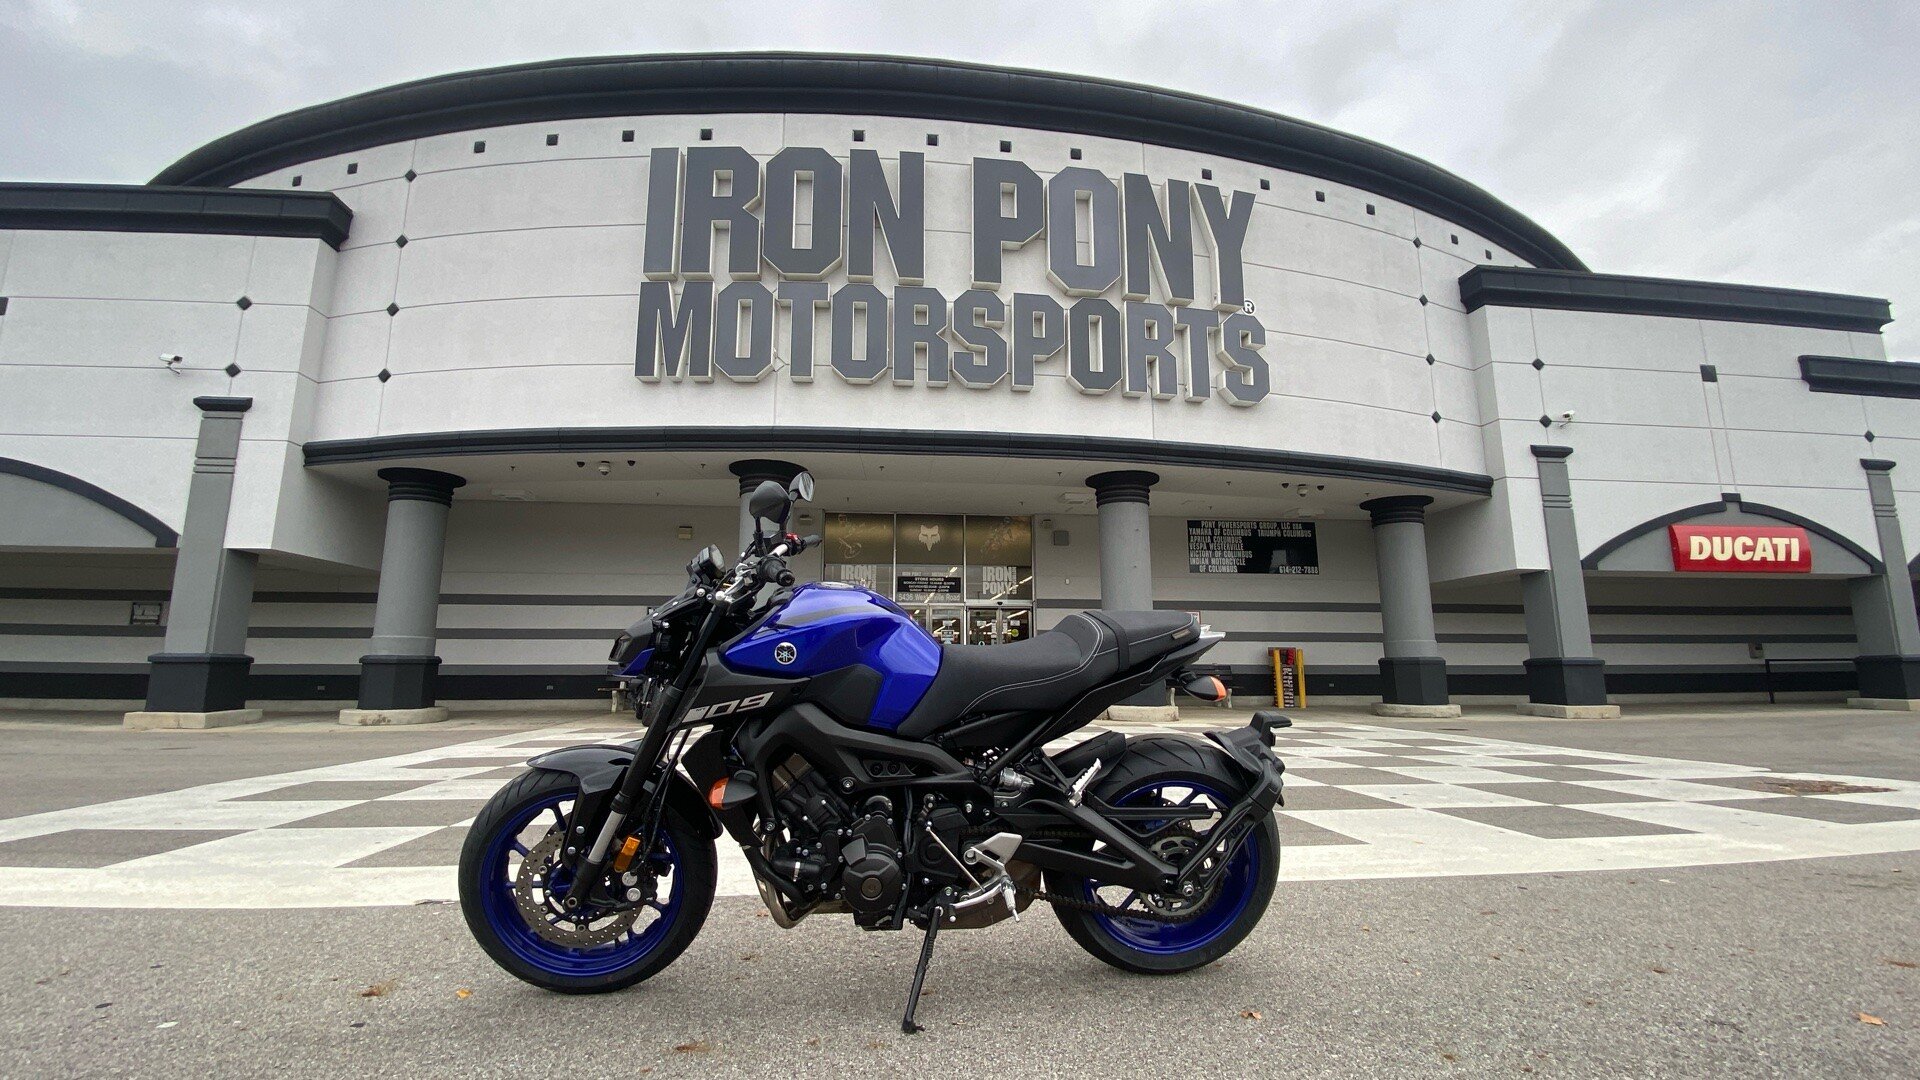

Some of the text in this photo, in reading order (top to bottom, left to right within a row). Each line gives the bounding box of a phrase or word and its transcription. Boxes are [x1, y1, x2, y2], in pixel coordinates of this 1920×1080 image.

[643, 146, 1256, 310] IRON PONY
[635, 281, 1270, 406] MOTORSPORTS
[1201, 521, 1216, 529] PONY
[1217, 521, 1258, 529] POWERSPORTS
[1281, 522, 1291, 530] LLC
[1189, 528, 1252, 537] YAMAHA OF COLUMBUS
[1258, 529, 1312, 538] TRIUMPH COLUMBUS
[1190, 535, 1243, 544] APRILIA COLUMBUS
[1209, 543, 1243, 551] WESTERVILLE
[1689, 535, 1800, 562] DUCATI
[1190, 550, 1253, 559] VICTORY OF COLUMBUS
[1190, 557, 1246, 566] INDIAN MOTORCYCLE
[841, 564, 872, 580] IRON
[982, 566, 1012, 581] IRON
[1199, 565, 1239, 573] OF COLUMBUS
[982, 581, 1012, 595] PONY
